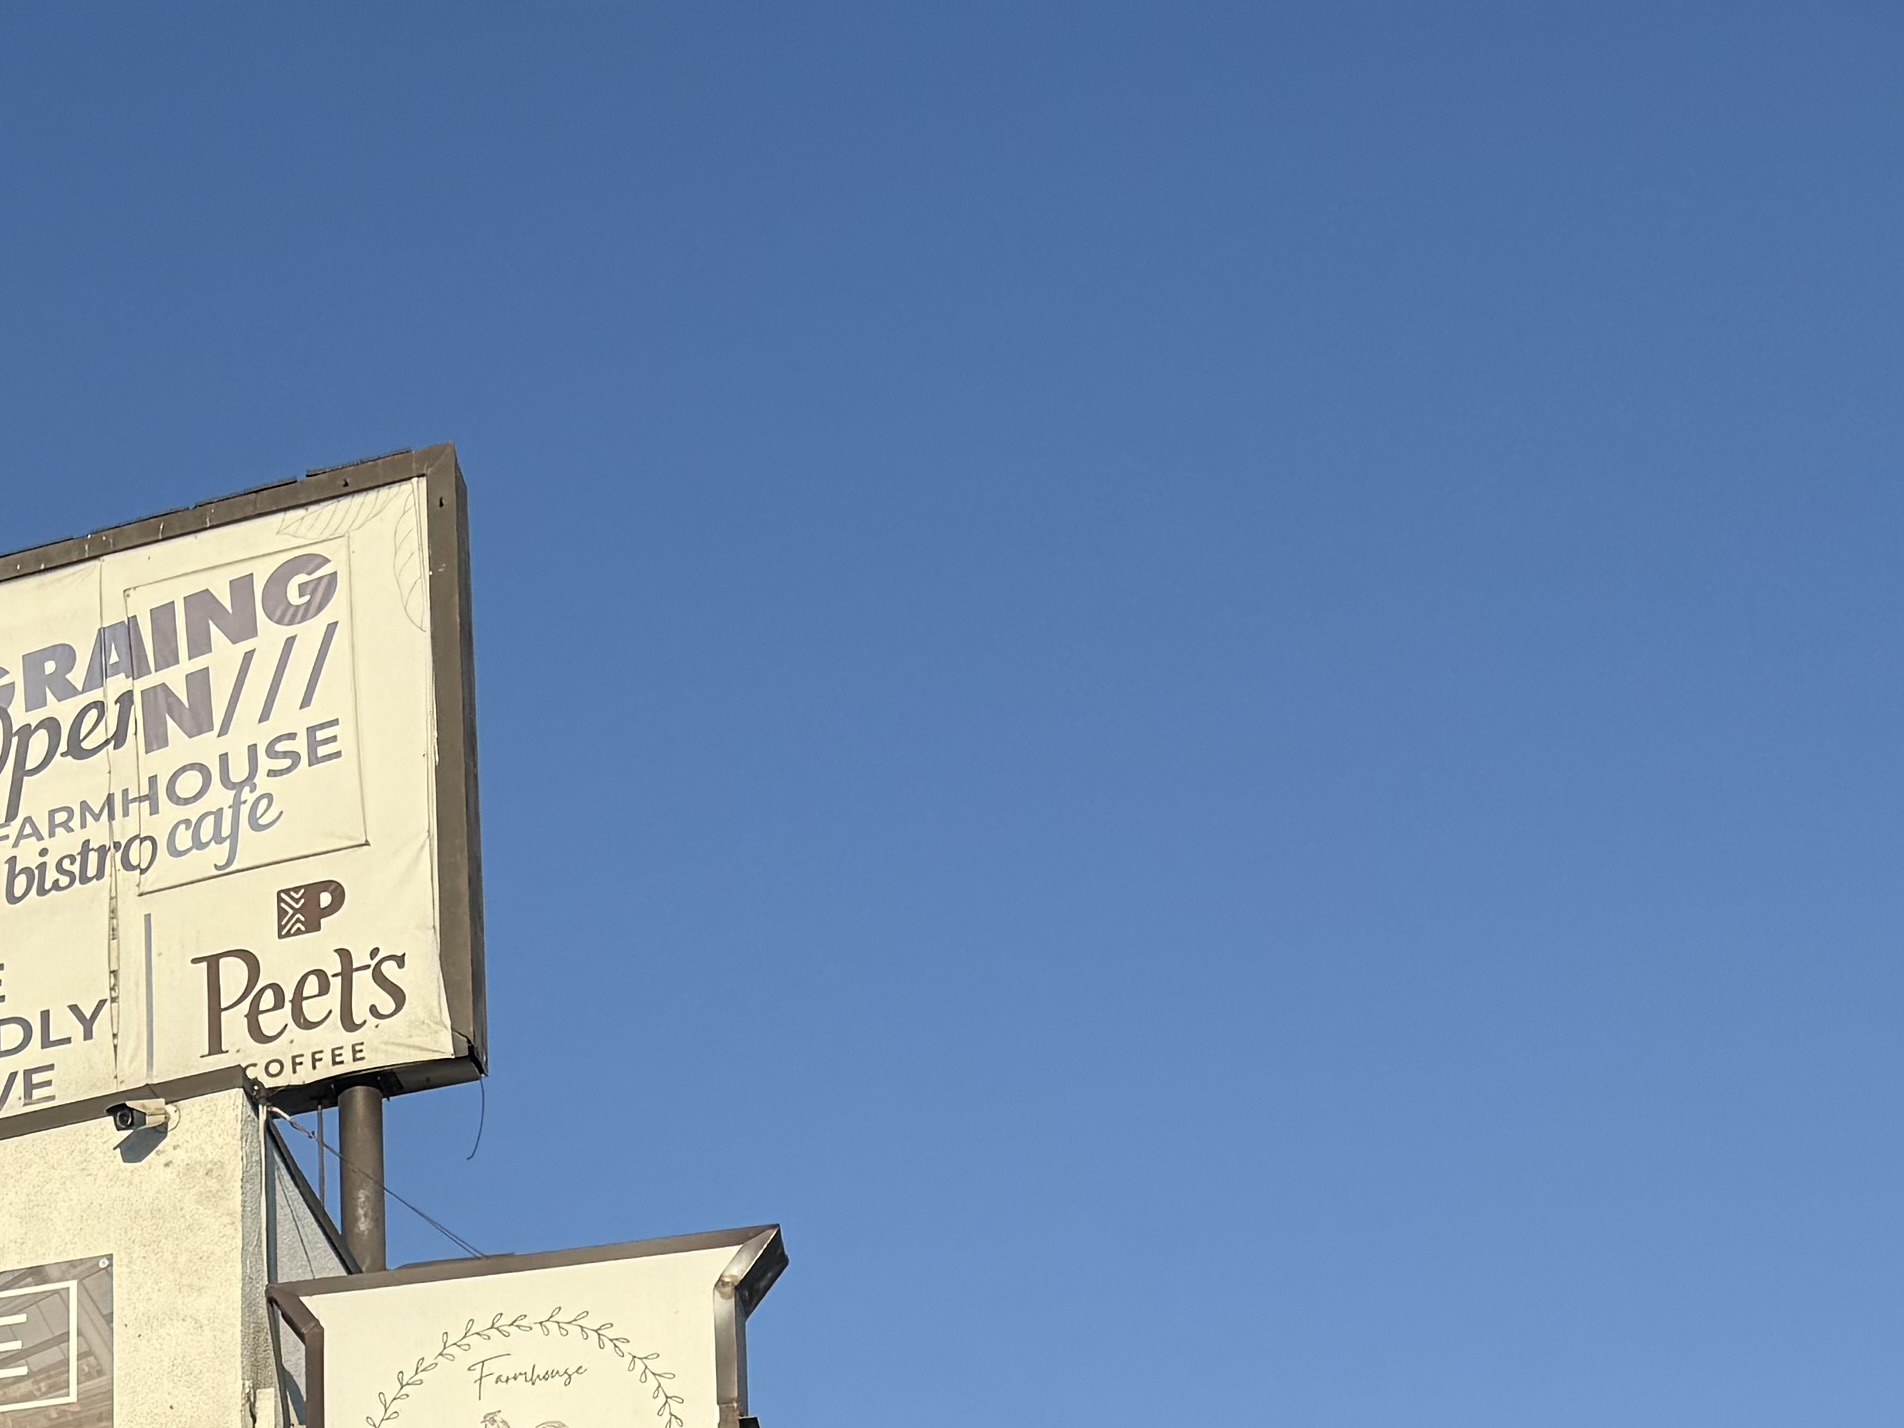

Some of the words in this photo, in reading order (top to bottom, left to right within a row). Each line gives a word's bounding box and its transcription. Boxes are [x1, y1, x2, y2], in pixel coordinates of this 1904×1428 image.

[5, 834, 158, 906] bistro
[167, 781, 284, 872] cafe
[191, 946, 407, 1059] Peet's
[244, 1041, 367, 1080] COFFEE
[467, 1353, 588, 1401] Farmhouse
